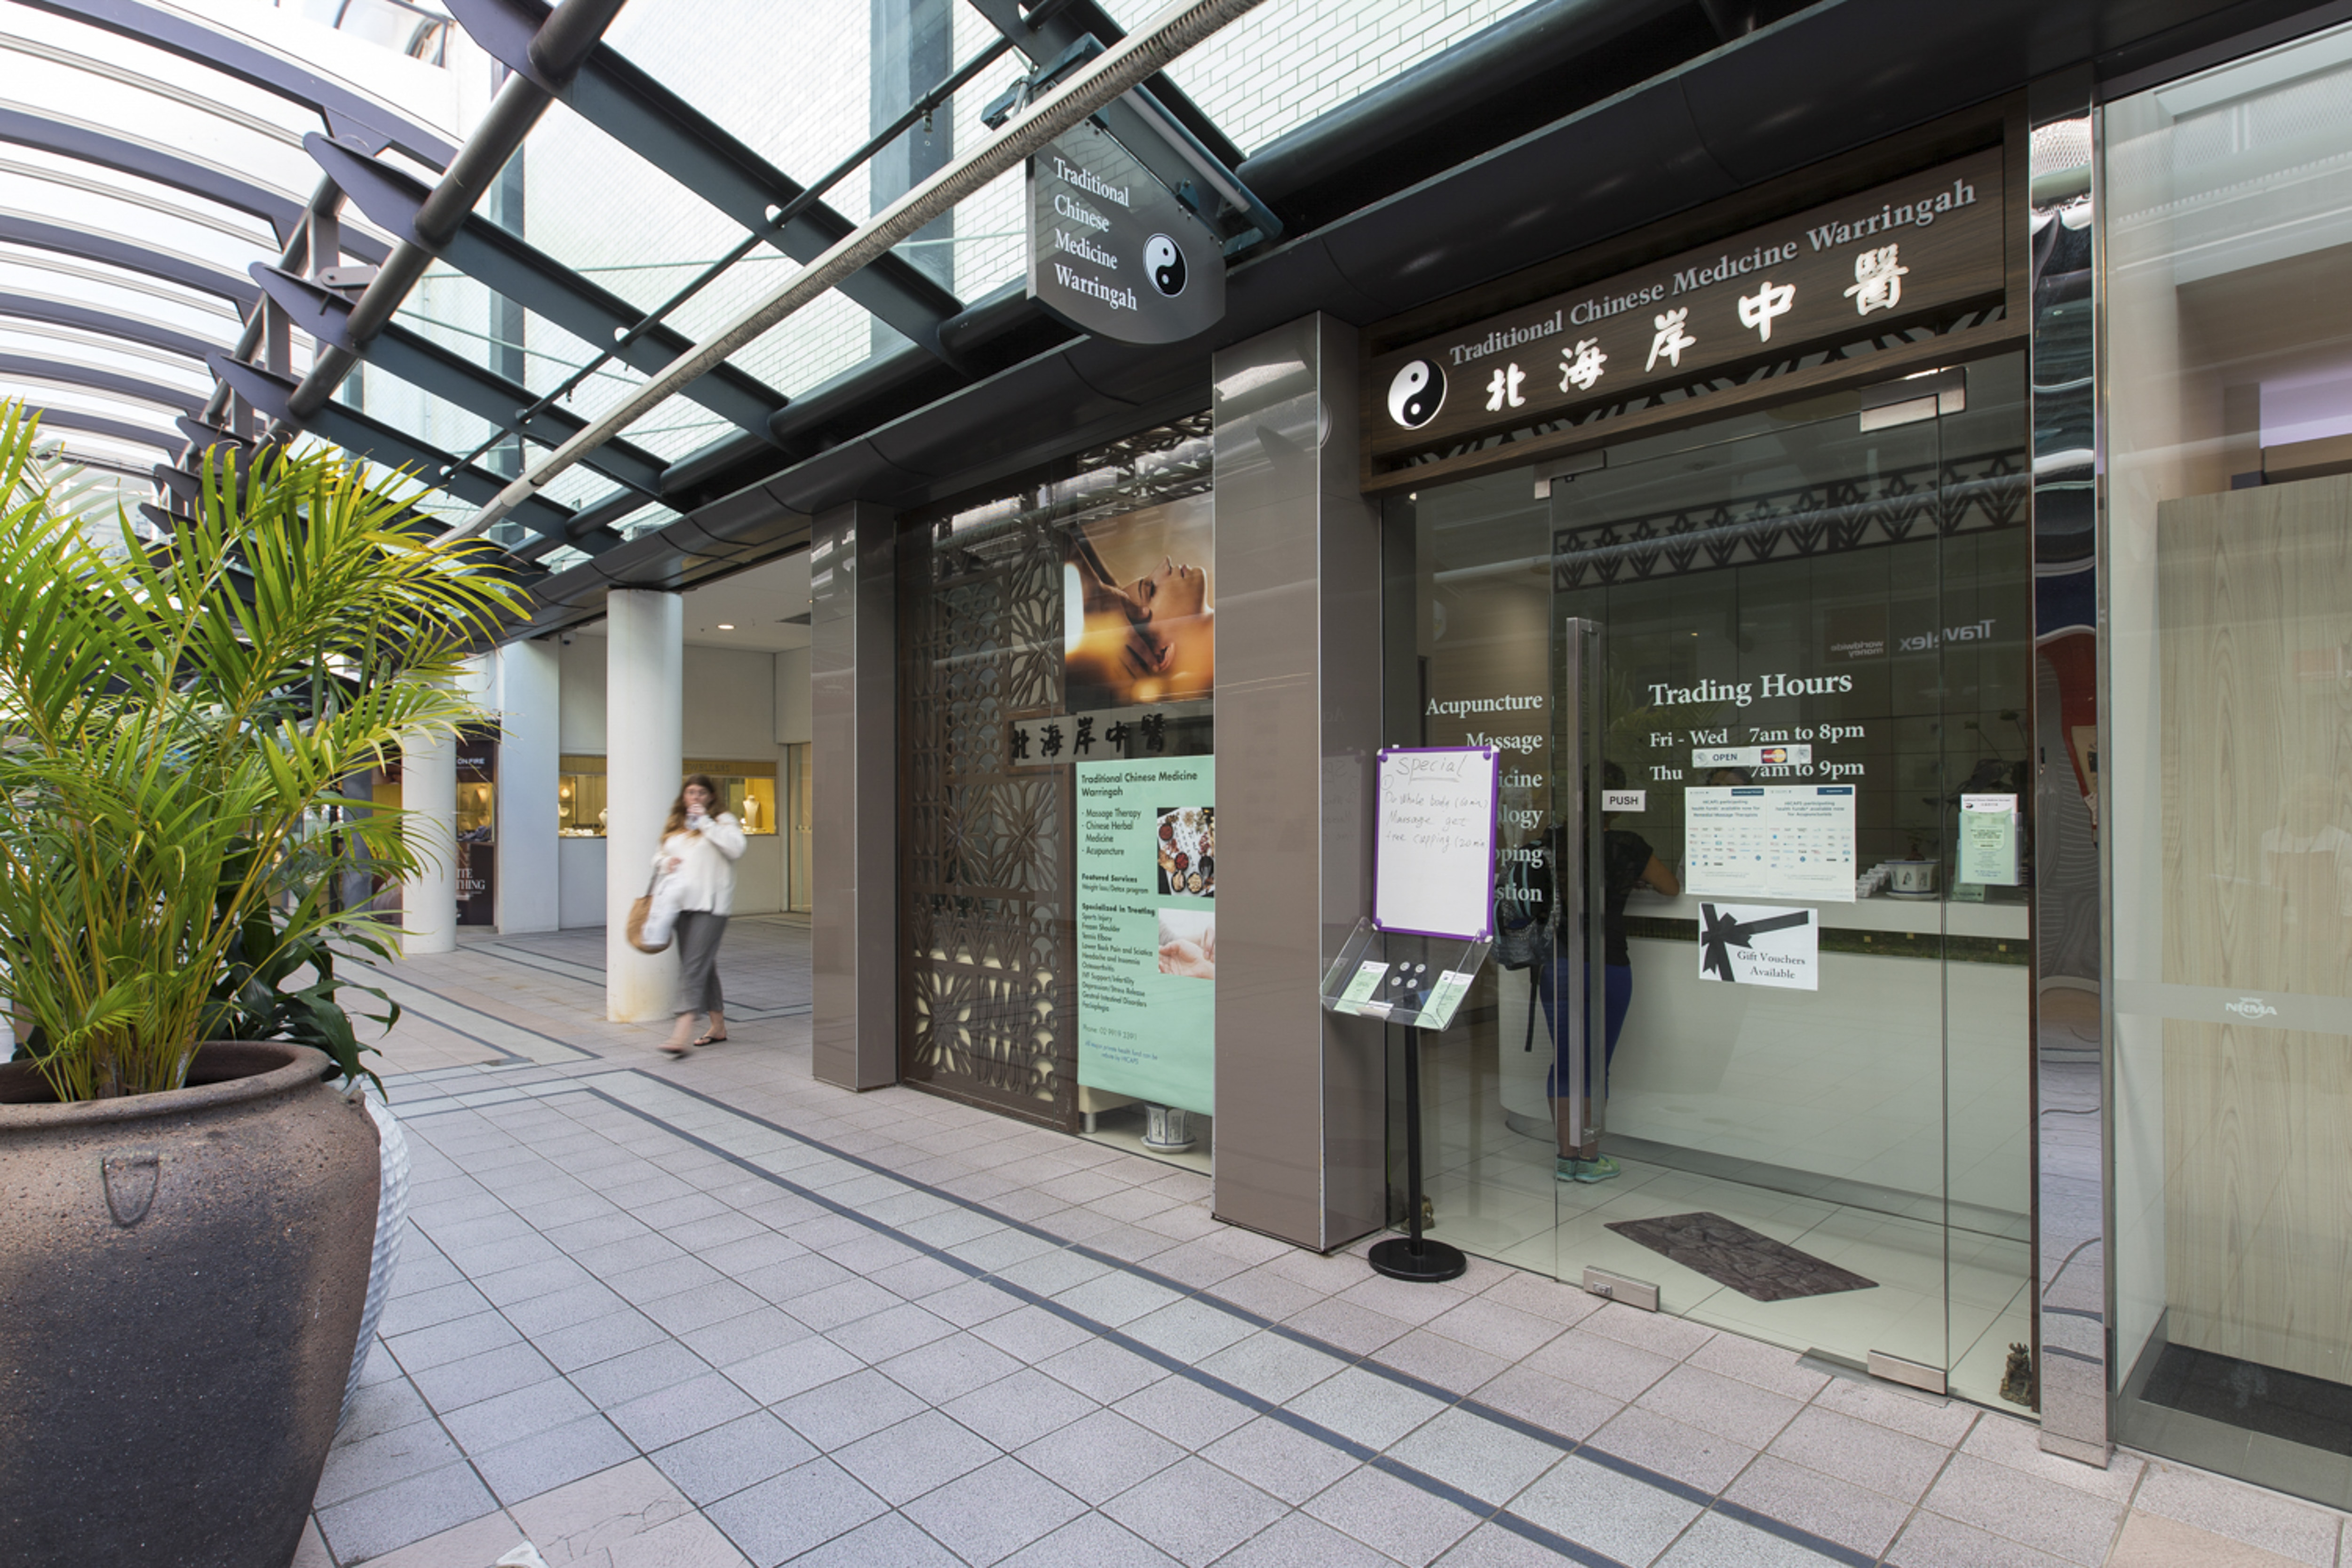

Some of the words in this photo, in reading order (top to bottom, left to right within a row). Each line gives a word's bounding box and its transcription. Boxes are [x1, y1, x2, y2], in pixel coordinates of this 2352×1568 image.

[1054, 156, 1129, 207] Traditional
[1054, 194, 1110, 233] Chinese
[1055, 229, 1118, 270] Medicine
[1449, 310, 1564, 366] Traditional
[1570, 283, 1665, 326] Chinese
[1672, 241, 1798, 295] Medicine
[1806, 178, 1977, 252] Warringah
[1054, 263, 1137, 311] Warringah
[1485, 243, 1910, 412] 北海岸中醫
[1648, 679, 1752, 707] Trading
[1760, 674, 1853, 699] Hours
[1425, 694, 1543, 719] Acupuncture
[1011, 713, 1165, 759] 北海岸中醫
[1466, 732, 1543, 755] Massage
[1649, 732, 1673, 748] Fri
[1689, 728, 1728, 746] Wed
[1749, 727, 1788, 743] 7am
[1795, 726, 1813, 741] to
[1819, 724, 1865, 743] 8pm
[1081, 772, 1123, 784] Traditional
[1124, 772, 1156, 783] Chinese
[1158, 769, 1198, 781] Medicine
[1396, 754, 1468, 785] Special
[1649, 765, 1683, 780] Thu
[1795, 764, 1814, 777] to
[1819, 760, 1865, 780] 9pm
[1081, 785, 1123, 799] Warringah
[1609, 796, 1639, 805] PUSH
[1086, 808, 1113, 820] Massage
[1114, 807, 1142, 820] Therapy
[1086, 820, 1110, 830] Chinese
[1111, 820, 1134, 830] Herbal
[1086, 833, 1114, 843] Medicine
[1086, 846, 1125, 857] Acupuncture
[1081, 873, 1109, 881] Featured
[1111, 875, 1138, 883] Services
[1127, 906, 1156, 918] Treating
[1099, 923, 1120, 932] Shoulder
[1097, 933, 1112, 941] Elbow
[1737, 950, 1757, 961] Gift
[1759, 952, 1806, 965] Vouchers
[1749, 965, 1796, 979] Available
[2225, 1002, 2278, 1016] NRMA
